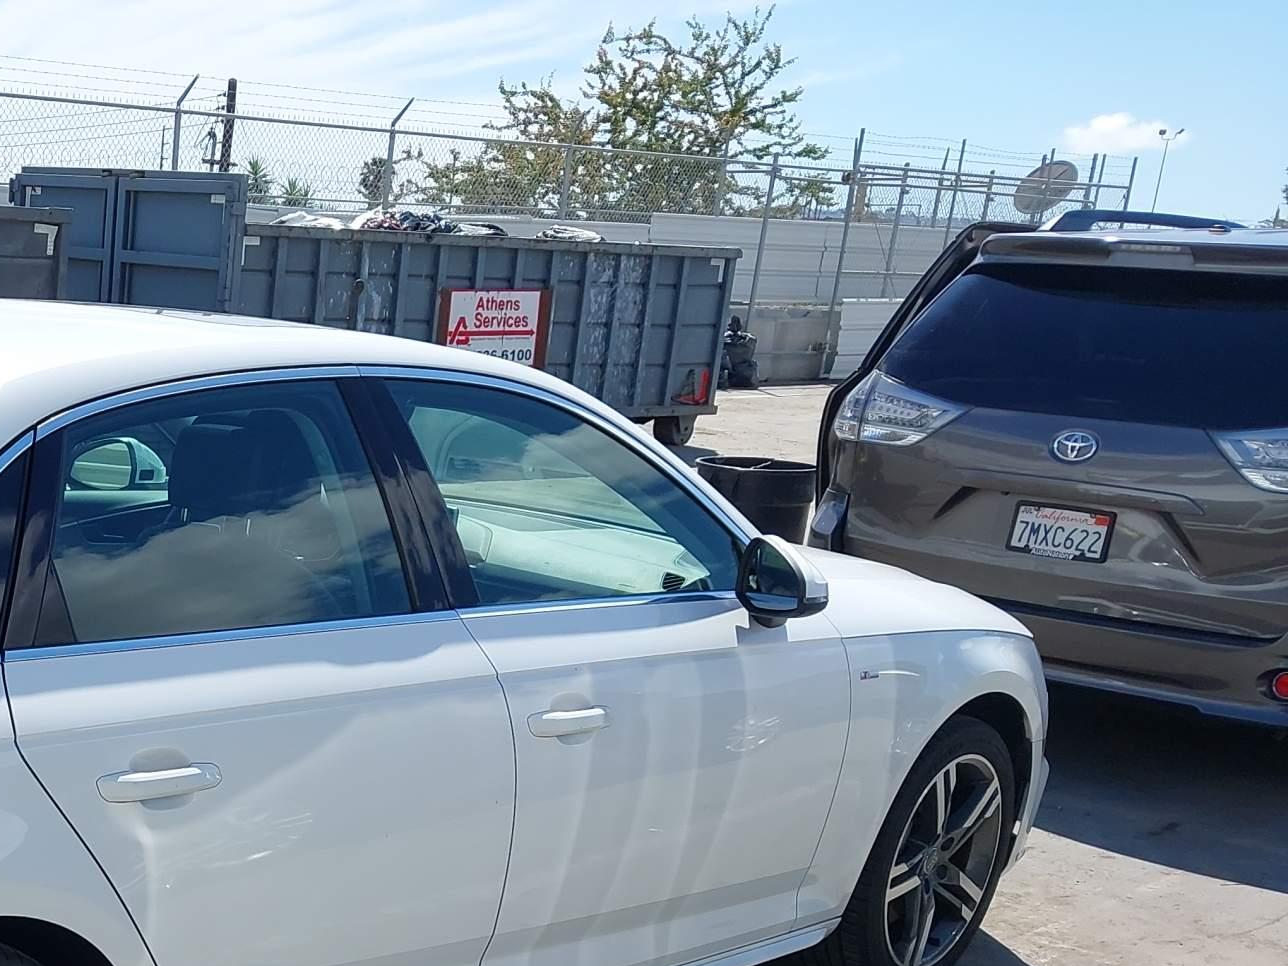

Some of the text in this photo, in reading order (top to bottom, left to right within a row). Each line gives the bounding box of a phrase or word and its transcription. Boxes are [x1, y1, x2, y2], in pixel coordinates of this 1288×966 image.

[476, 296, 521, 311] Athens
[474, 312, 529, 329] Services
[1035, 510, 1089, 525] California
[1017, 520, 1102, 554] 7MXC622
